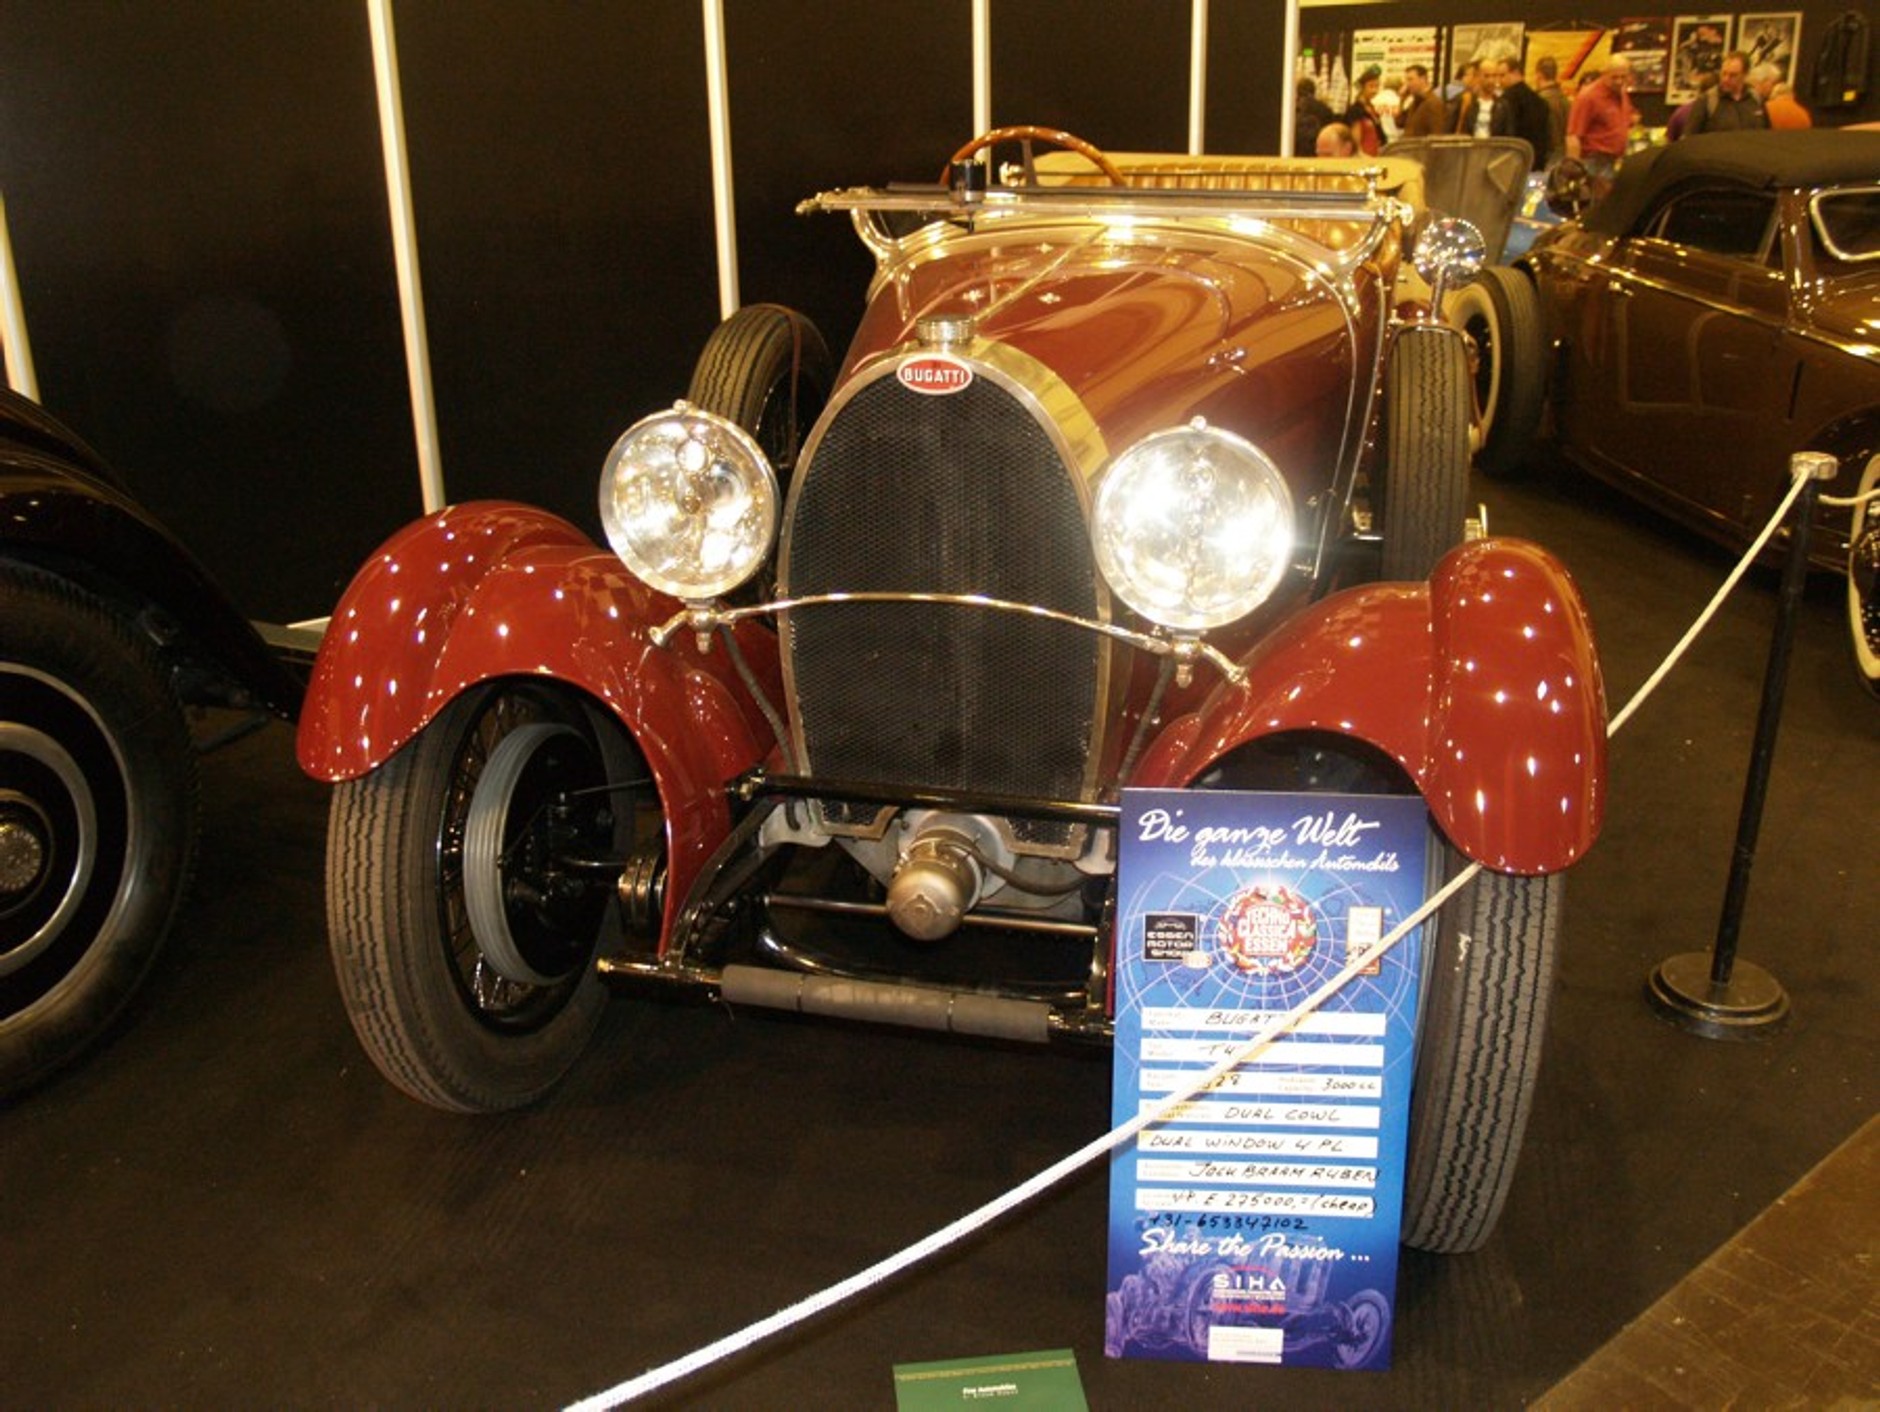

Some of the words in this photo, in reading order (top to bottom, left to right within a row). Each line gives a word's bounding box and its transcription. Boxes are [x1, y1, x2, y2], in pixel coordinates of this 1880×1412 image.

[904, 367, 965, 384] BUGATTI
[1138, 808, 1190, 844] Die
[1190, 824, 1288, 858] ganze
[1291, 811, 1381, 848] Welt
[1224, 1106, 1274, 1120] DUAL
[1285, 1109, 1340, 1121] COWL
[1139, 1228, 1212, 1255] Share
[1217, 1232, 1253, 1257] the
[1259, 1233, 1345, 1261] Passion
[1213, 1273, 1287, 1291] SIHA
